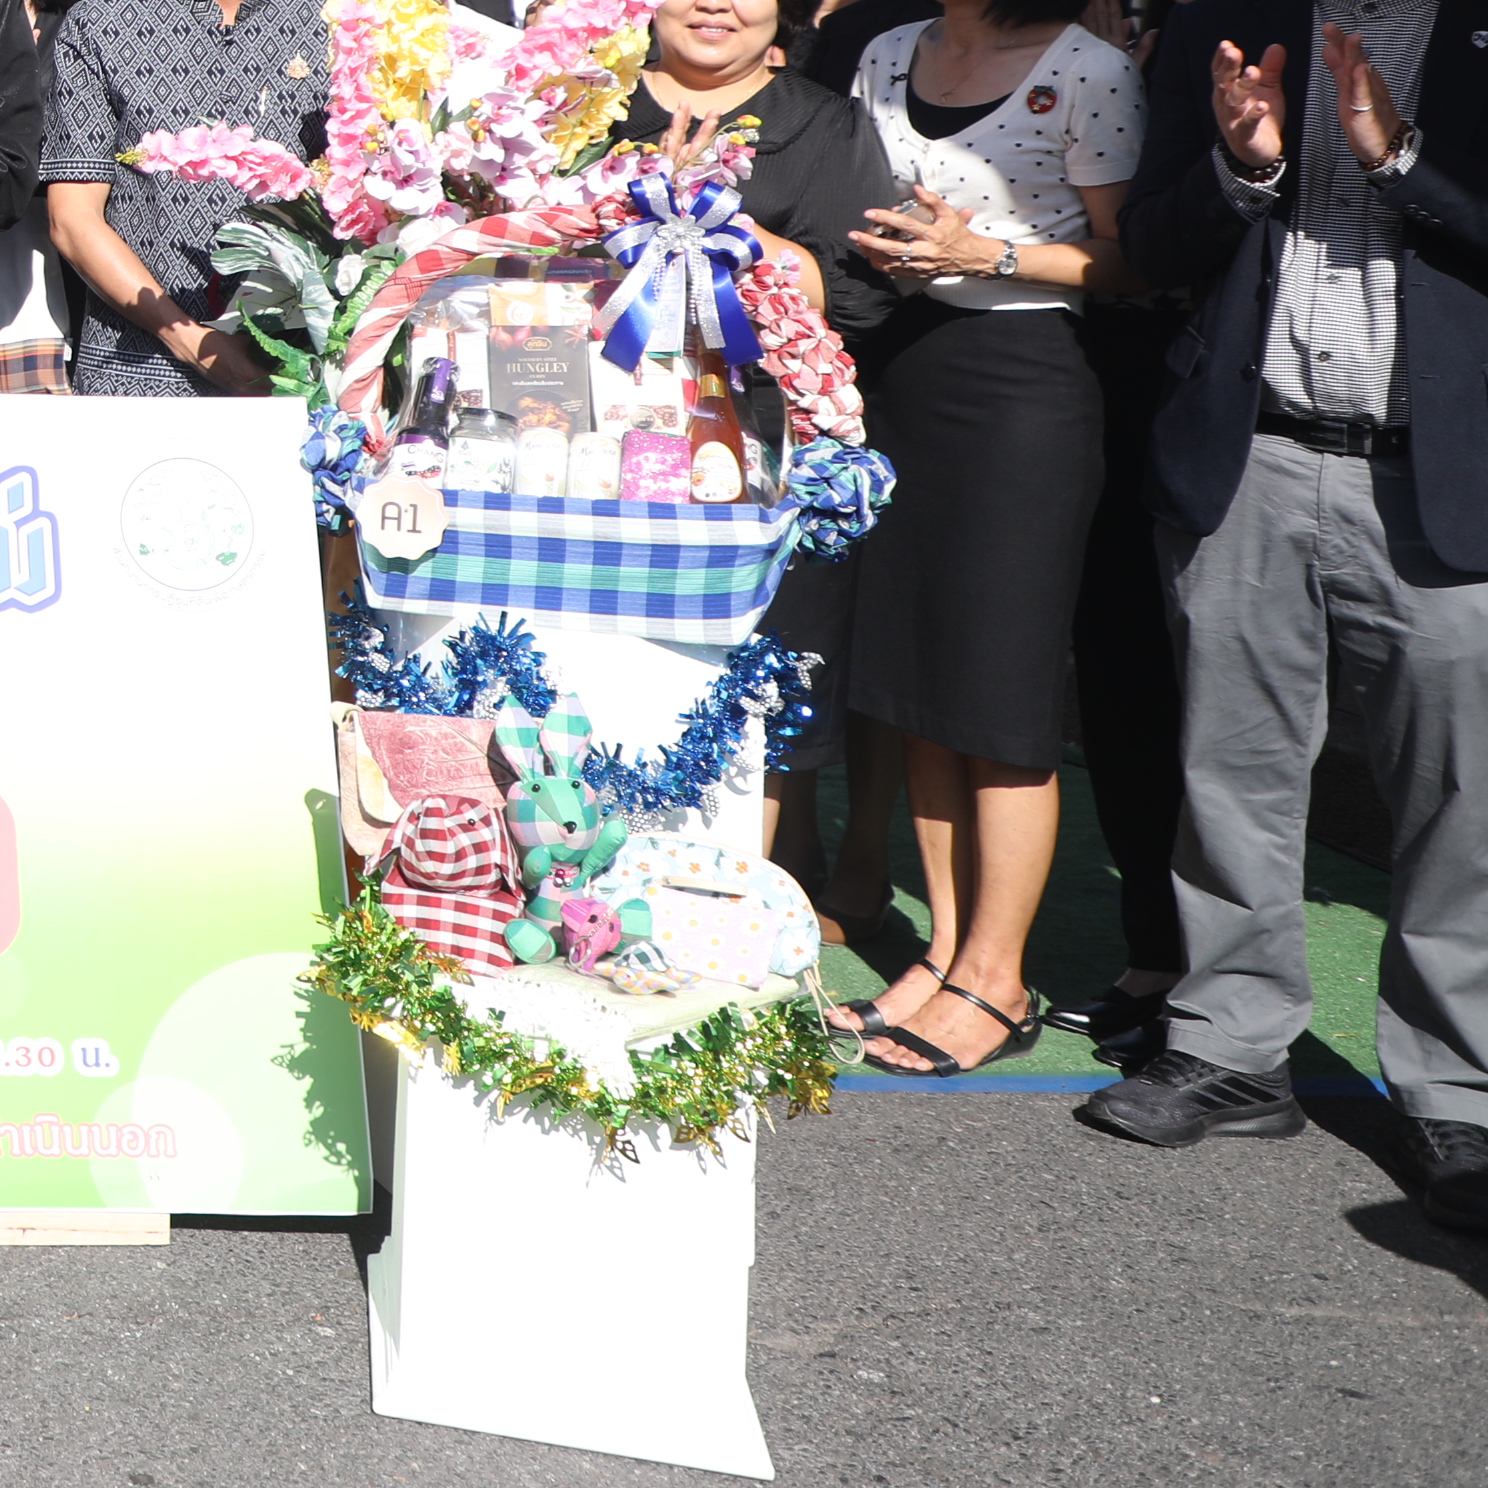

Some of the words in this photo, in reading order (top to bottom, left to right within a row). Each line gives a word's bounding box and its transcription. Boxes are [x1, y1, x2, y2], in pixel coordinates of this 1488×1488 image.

[506, 362, 570, 374] HUNGLEY
[380, 501, 422, 534] A1
[78, 1047, 113, 1070] น.
